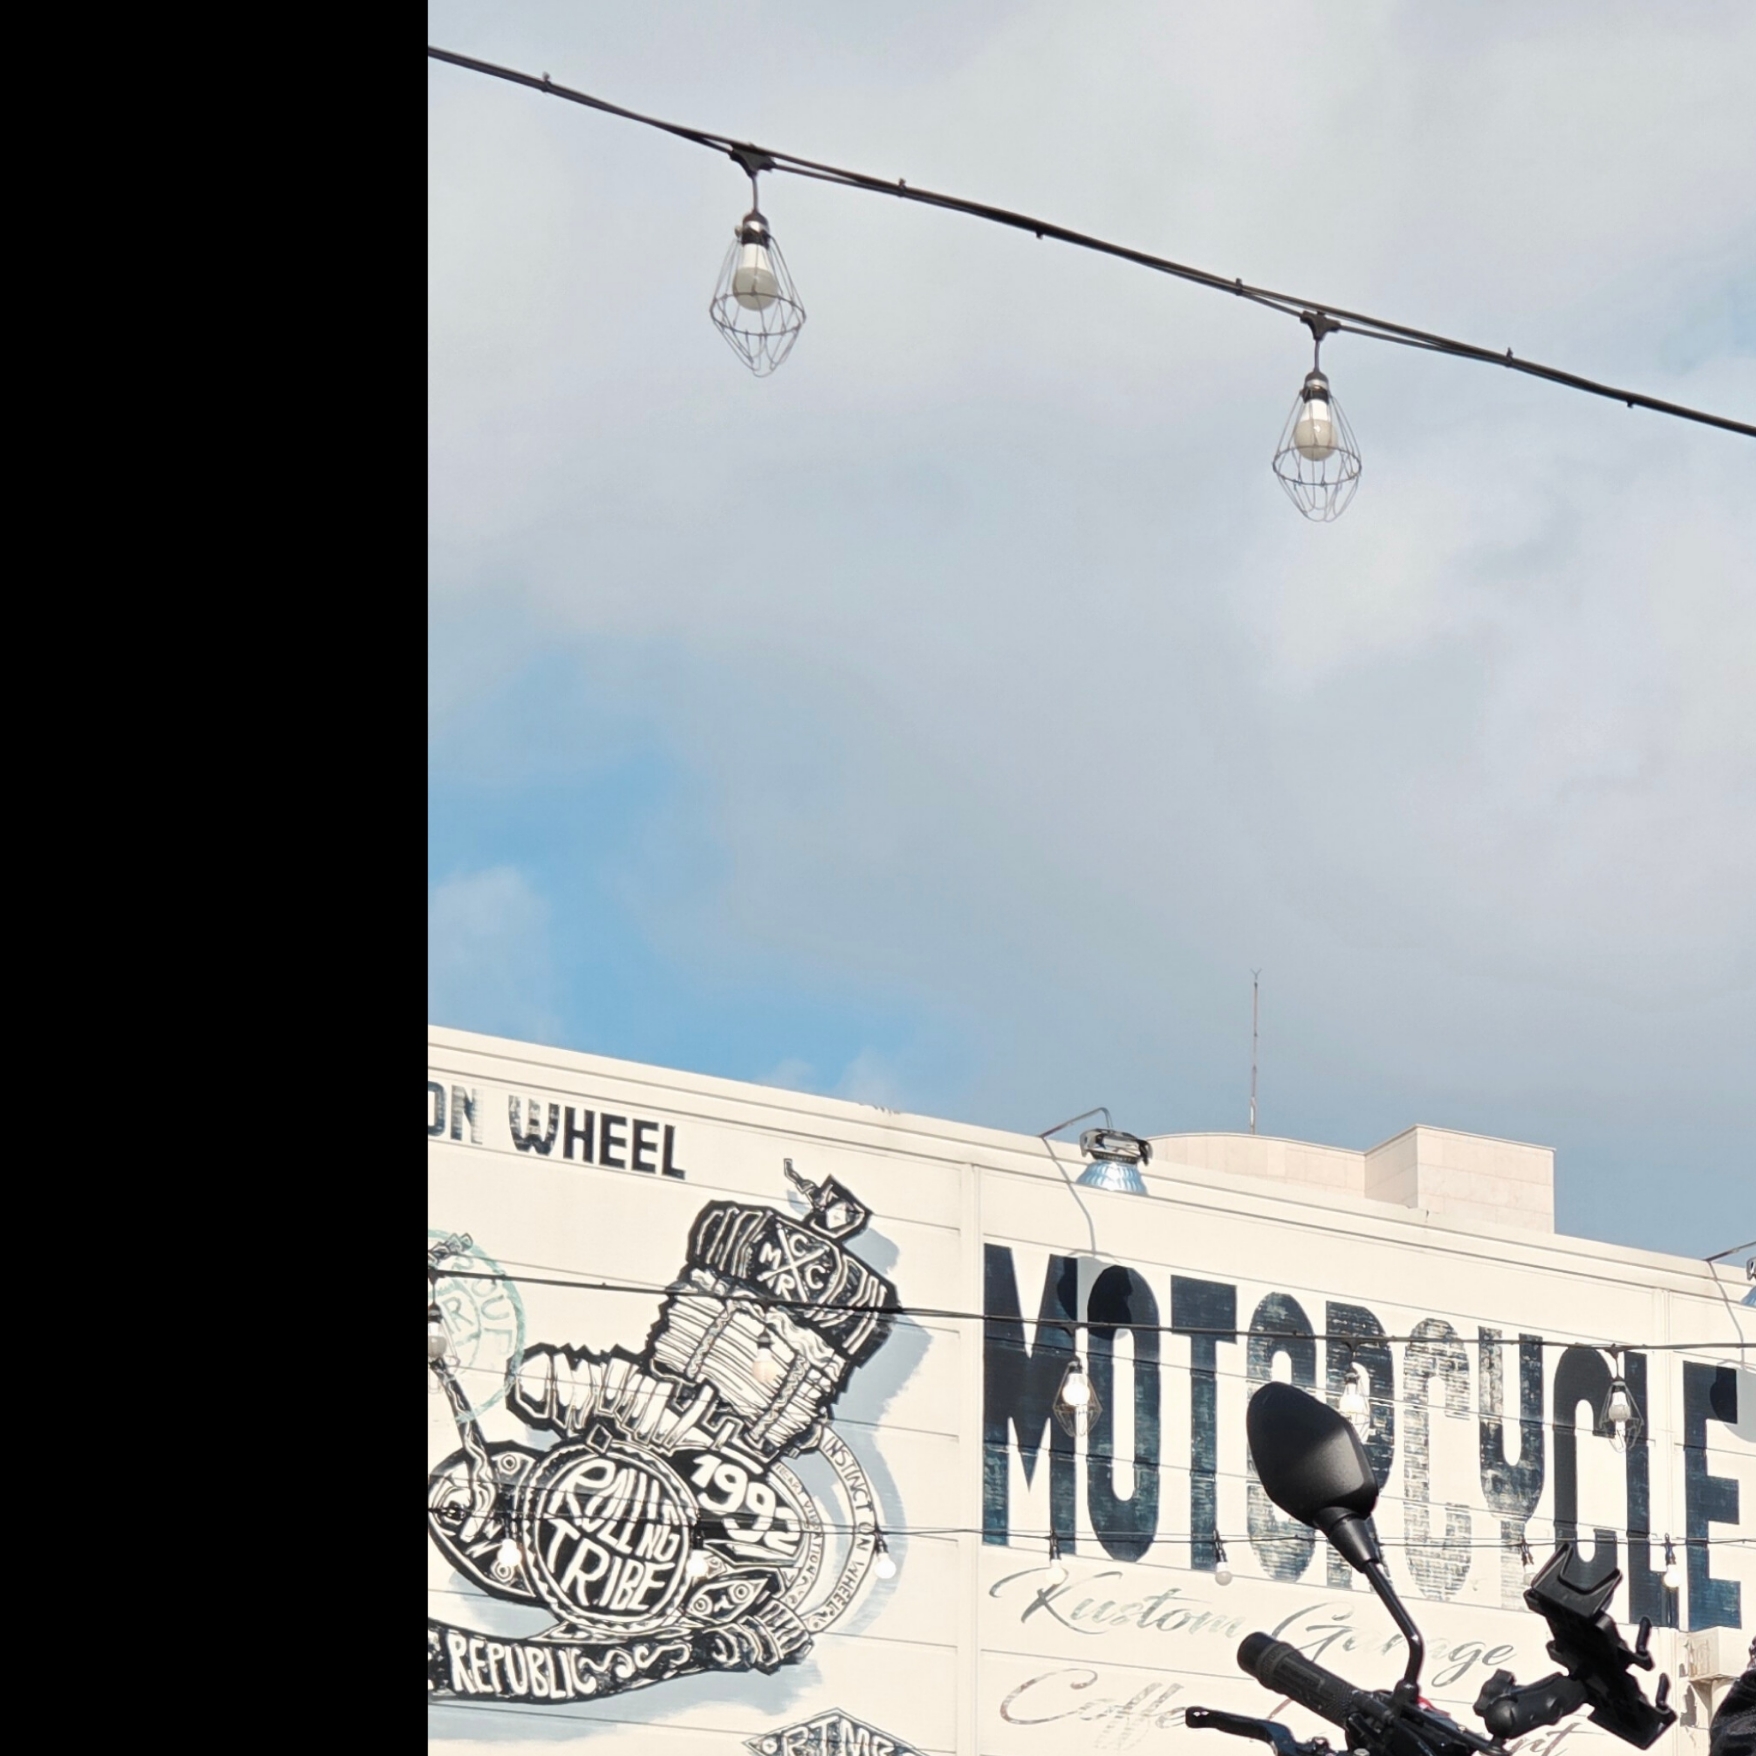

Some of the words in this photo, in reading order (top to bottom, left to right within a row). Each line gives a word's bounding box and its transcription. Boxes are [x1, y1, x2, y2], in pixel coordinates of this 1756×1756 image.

[507, 1094, 686, 1181] WHEEL
[824, 1436, 876, 1514] INSTINCT
[983, 1243, 1742, 1630] MOTORCYCLE
[547, 1459, 681, 1562] ROLLING
[690, 1453, 802, 1557] 1992
[547, 1517, 676, 1611] TRIBE
[988, 1566, 1246, 1637] Kustom
[447, 1629, 598, 1699] REPUBLIC
